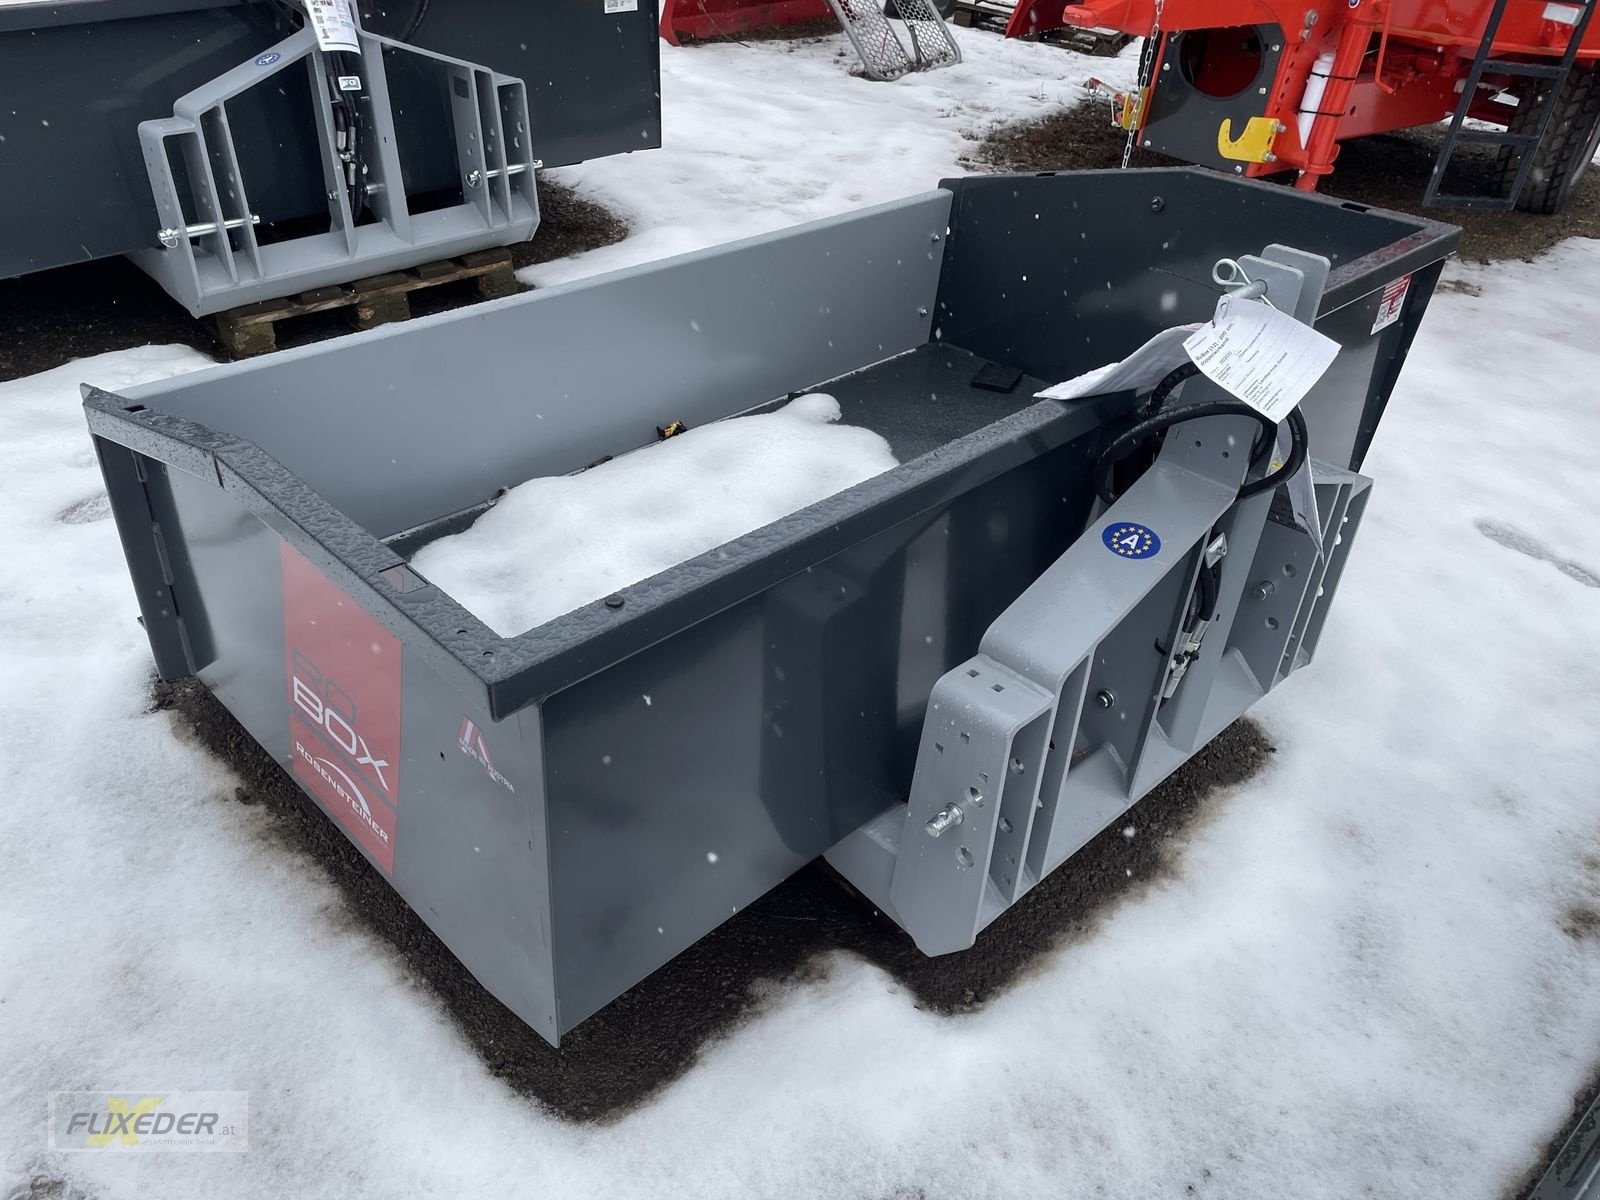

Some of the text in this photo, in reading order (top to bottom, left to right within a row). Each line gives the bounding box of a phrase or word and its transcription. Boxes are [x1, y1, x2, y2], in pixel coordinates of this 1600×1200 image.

[1119, 533, 1140, 550] A
[292, 675, 390, 792] BOX
[295, 741, 390, 844] ROSENSTEINER
